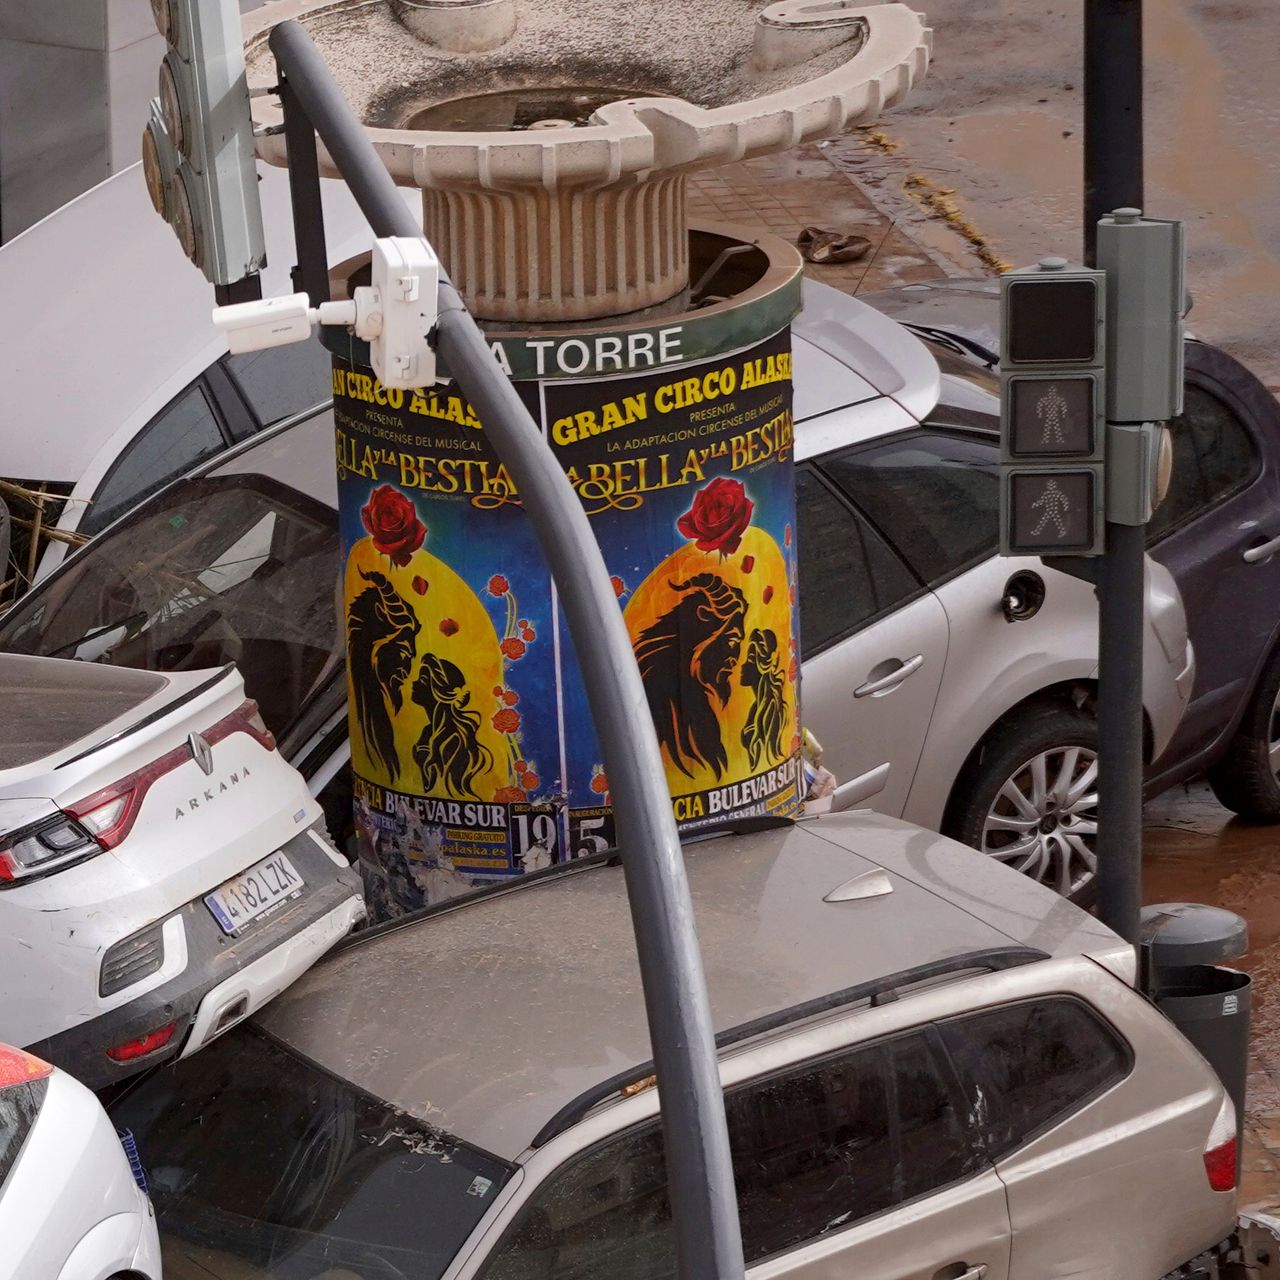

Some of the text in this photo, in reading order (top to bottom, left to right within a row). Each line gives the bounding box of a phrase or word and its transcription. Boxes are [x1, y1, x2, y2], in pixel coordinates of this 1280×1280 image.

[526, 326, 684, 378] TORRE
[365, 409, 404, 428] PRESENTA
[409, 386, 484, 430] ALAS
[552, 392, 648, 446] GRAN
[654, 366, 737, 415] CIRCO
[689, 402, 737, 423] PRESENTA
[415, 435, 433, 448] DEL
[434, 438, 483, 452] MUSICAL
[607, 441, 621, 454] LA
[624, 424, 696, 451] ADAPTACION
[698, 411, 744, 436] CIRCENSE
[399, 453, 519, 503] BESTIA
[579, 448, 706, 513] BELLA
[175, 767, 251, 821] ARKANA
[708, 770, 777, 814] BULEVAR
[463, 804, 507, 828] SUR
[511, 814, 557, 857] 19
[221, 876, 269, 918] 4182
[257, 856, 298, 896] LZK
